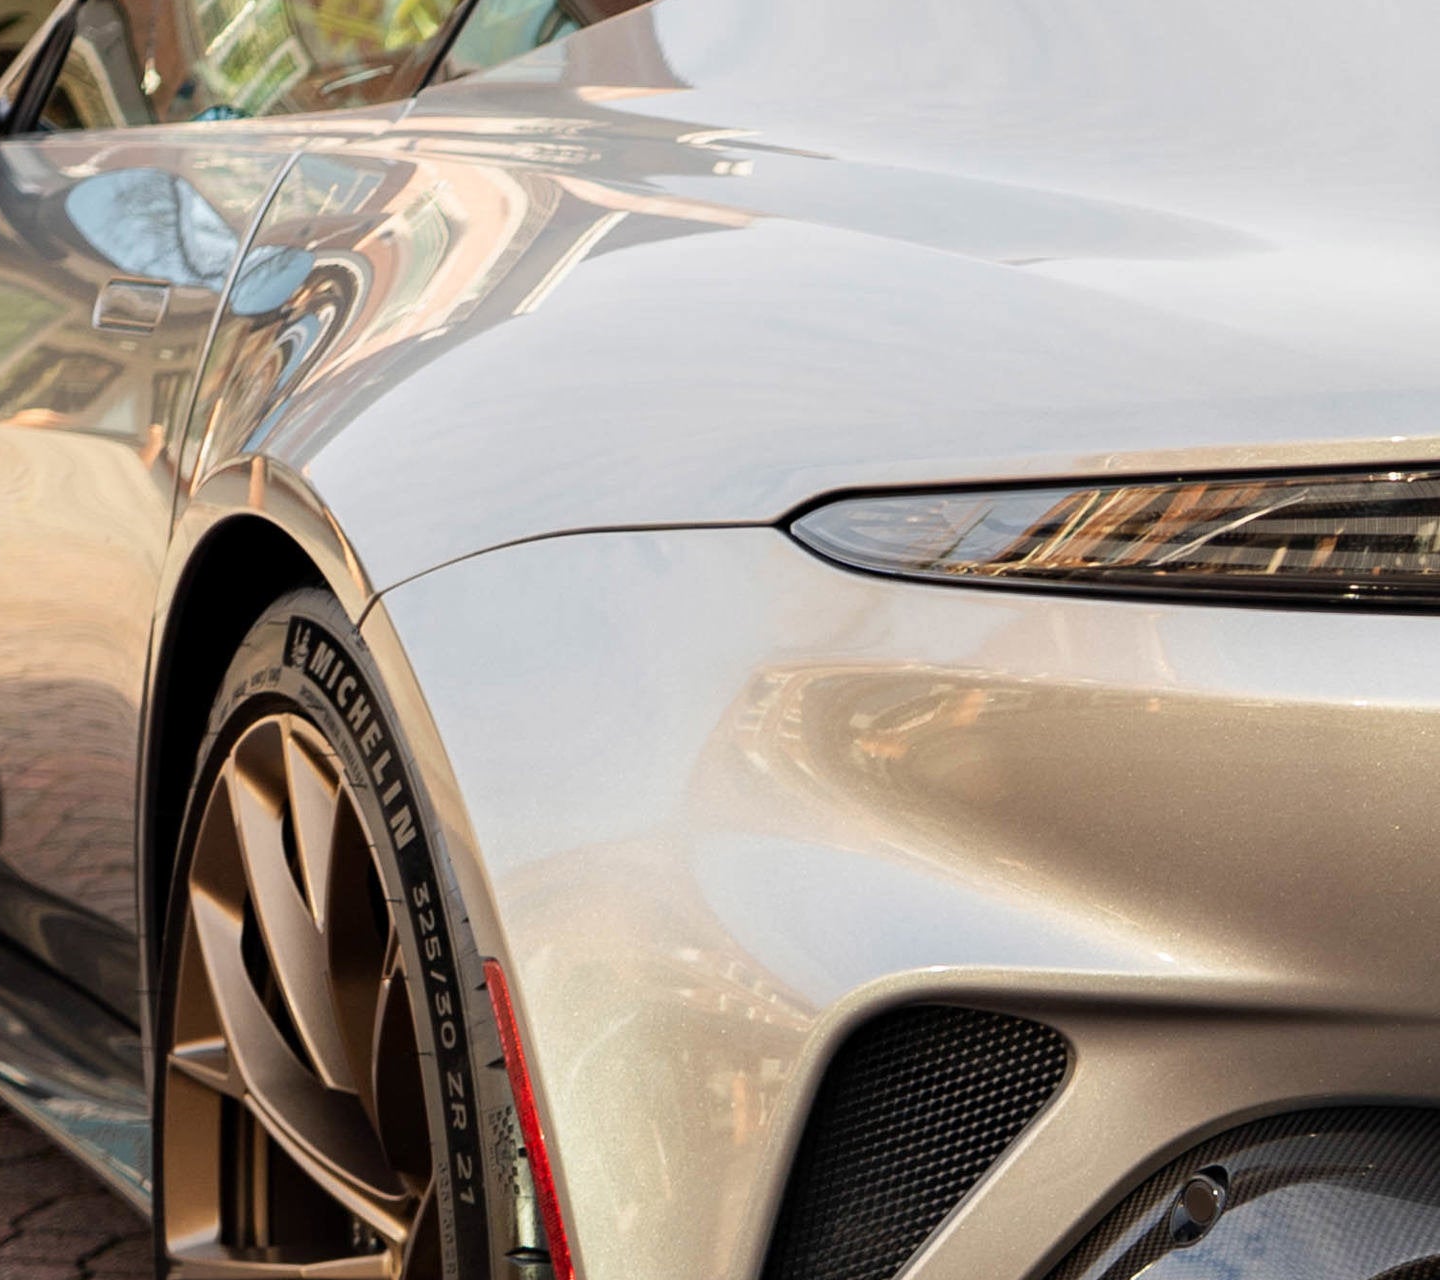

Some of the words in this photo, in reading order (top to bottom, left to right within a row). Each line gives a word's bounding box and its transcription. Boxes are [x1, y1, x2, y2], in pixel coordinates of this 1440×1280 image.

[309, 641, 417, 850] MICHELIN
[412, 880, 457, 1050] 325/30
[447, 1071, 468, 1131] ZR
[457, 1154, 475, 1206] 21
